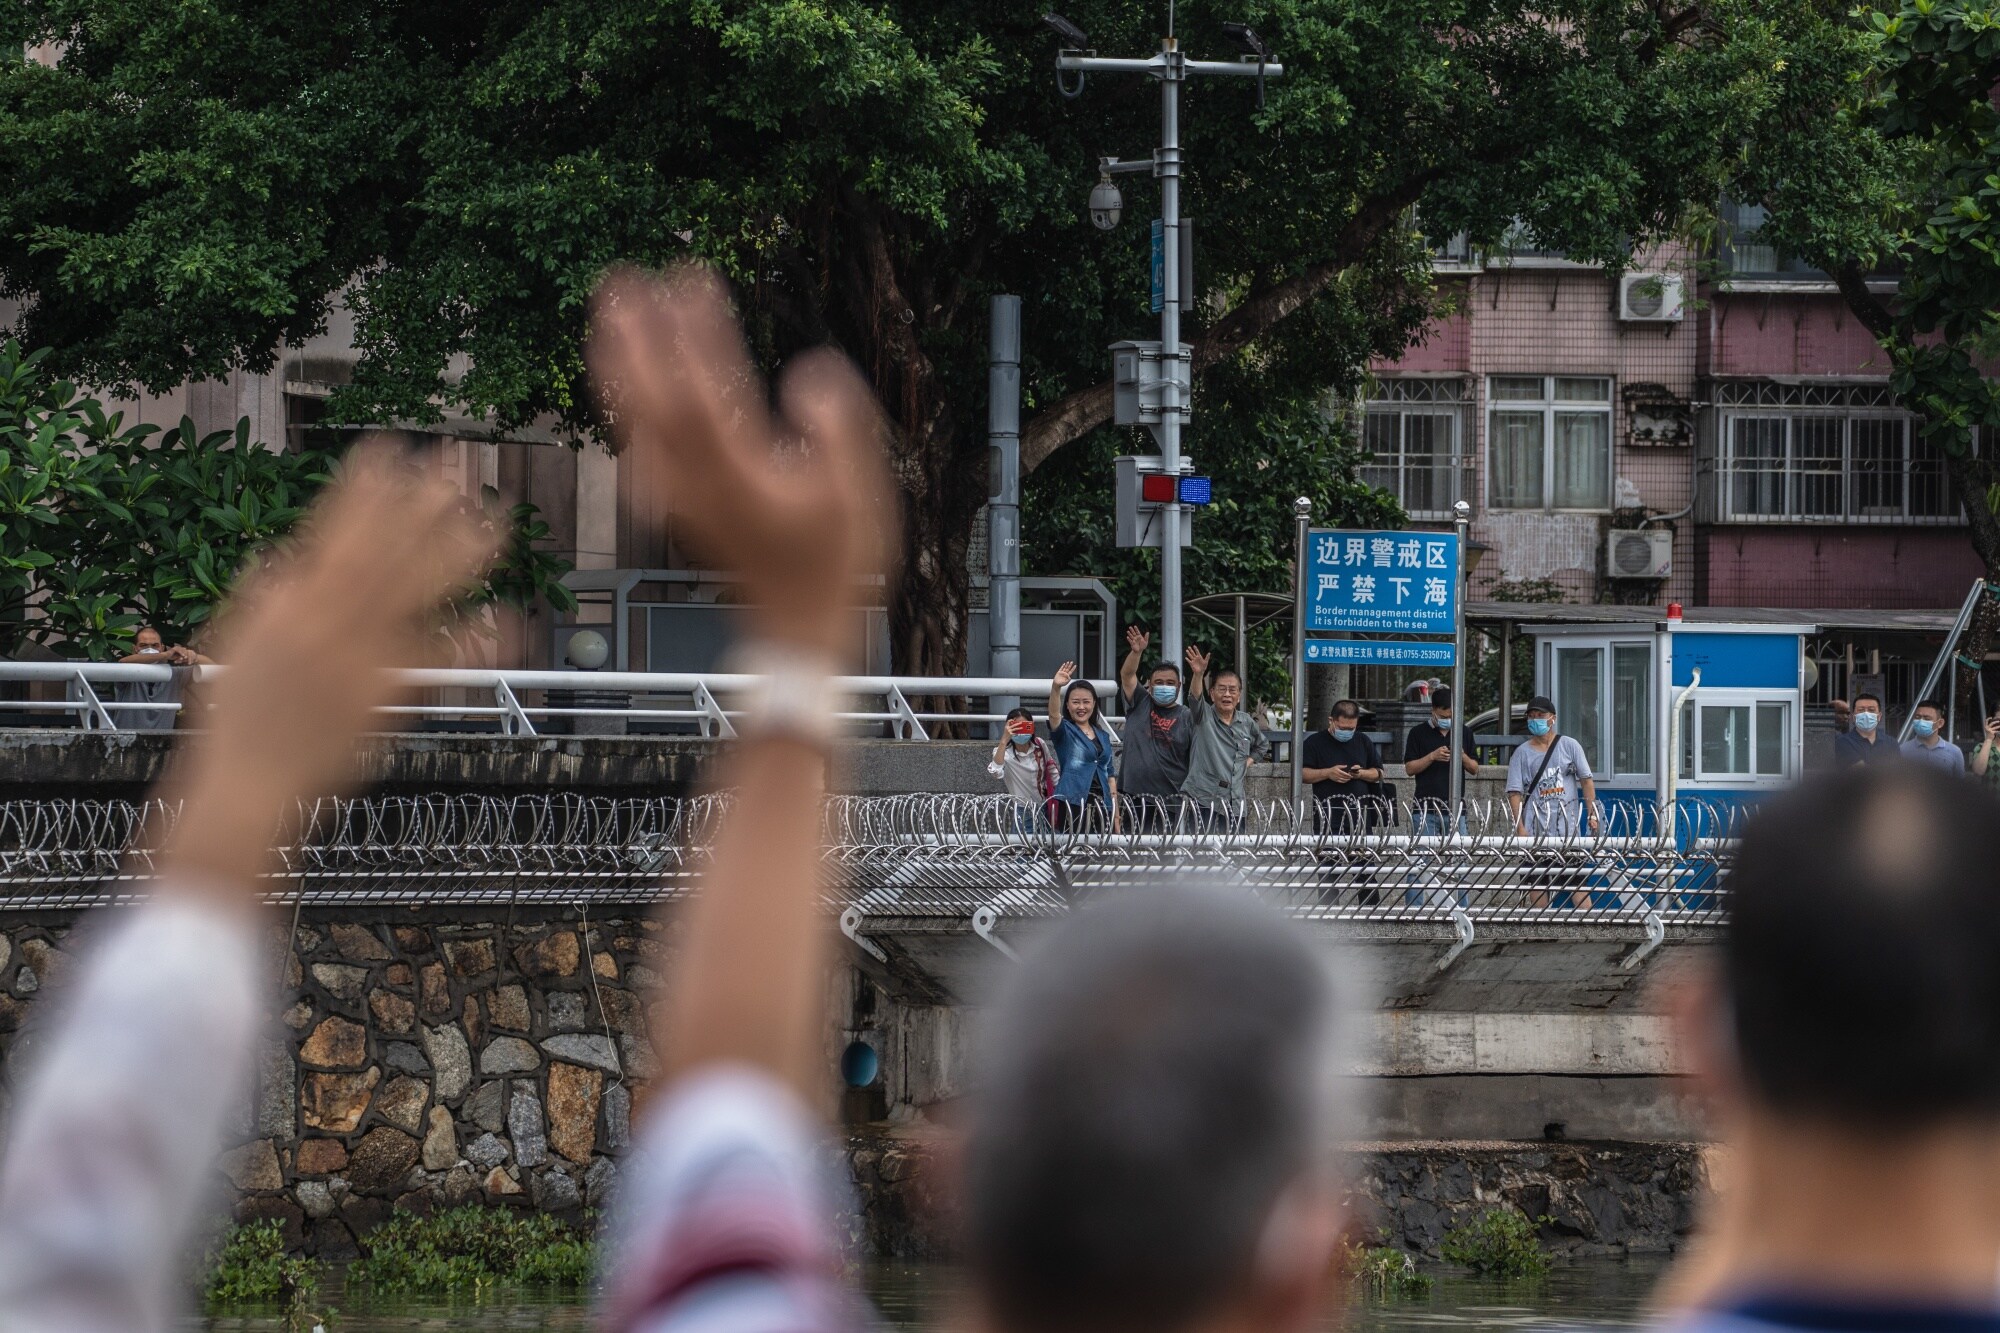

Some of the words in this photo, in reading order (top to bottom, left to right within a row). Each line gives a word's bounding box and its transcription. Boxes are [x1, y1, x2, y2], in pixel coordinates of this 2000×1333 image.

[1316, 537, 1448, 569] 边界警戒区
[1315, 573, 1448, 607] 严禁下海
[1315, 605, 1348, 616] Border
[1349, 608, 1411, 619] management
[1413, 609, 1447, 619] district
[1314, 616, 1322, 625] it
[1324, 616, 1332, 626] is
[1333, 617, 1380, 627] forbidden
[1382, 619, 1392, 628] to
[1394, 619, 1409, 629] the
[1321, 646, 1373, 658] 武警执勤第三支队
